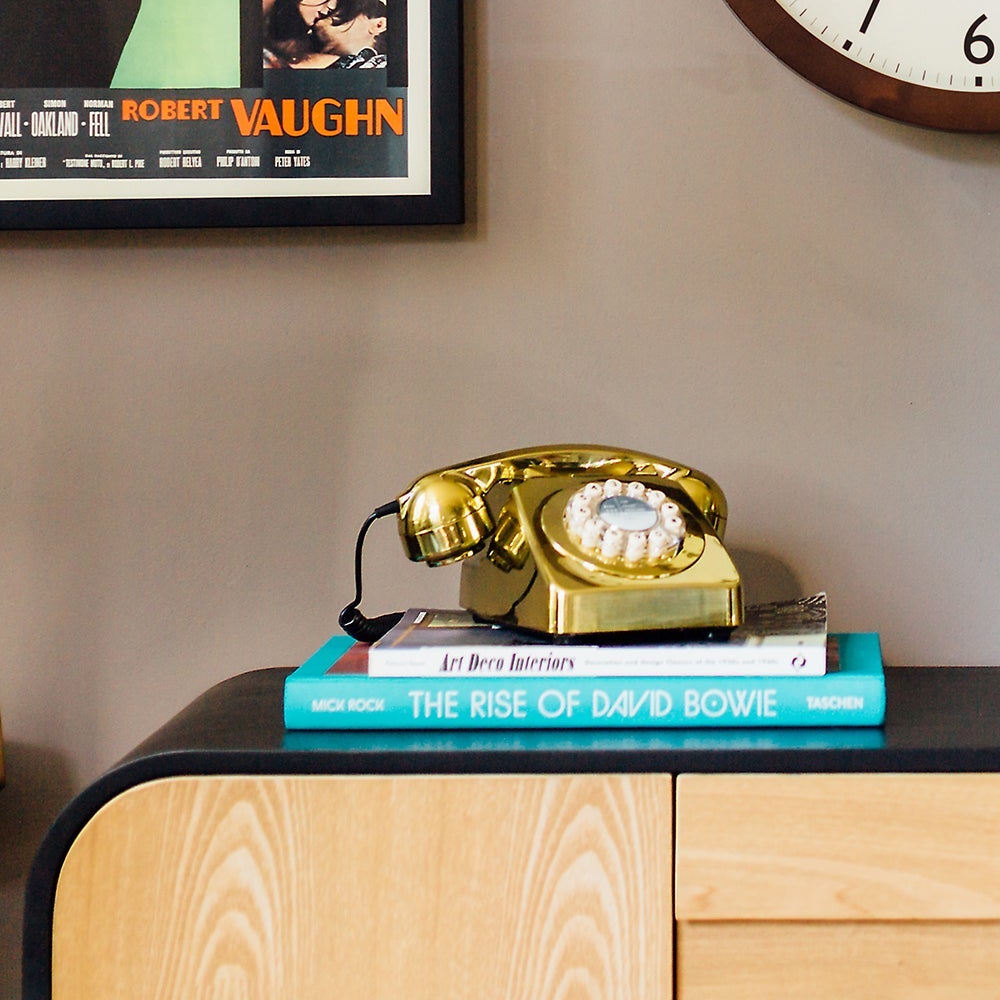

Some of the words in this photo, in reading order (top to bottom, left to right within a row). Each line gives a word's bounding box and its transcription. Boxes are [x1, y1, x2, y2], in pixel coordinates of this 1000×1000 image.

[963, 13, 995, 65] 6
[43, 99, 67, 109] SIMON
[83, 99, 114, 109] NORMAN
[31, 110, 79, 138] OAKLAND
[89, 111, 111, 138] FELL
[121, 98, 224, 122] ROBERT
[229, 97, 404, 137] VAUGHN
[274, 156, 292, 168] PETER
[293, 156, 311, 168] YATES
[439, 653, 465, 672] Art
[468, 653, 505, 672] Deco
[508, 651, 576, 672] Interiors
[311, 698, 345, 713] MICK
[348, 698, 385, 712] ROCK
[408, 688, 460, 719] THE
[469, 687, 529, 719] RISE
[537, 687, 582, 718] OF
[591, 687, 674, 718] DAVID
[682, 686, 778, 718] BOWIE
[805, 695, 865, 710] TASCHEN
